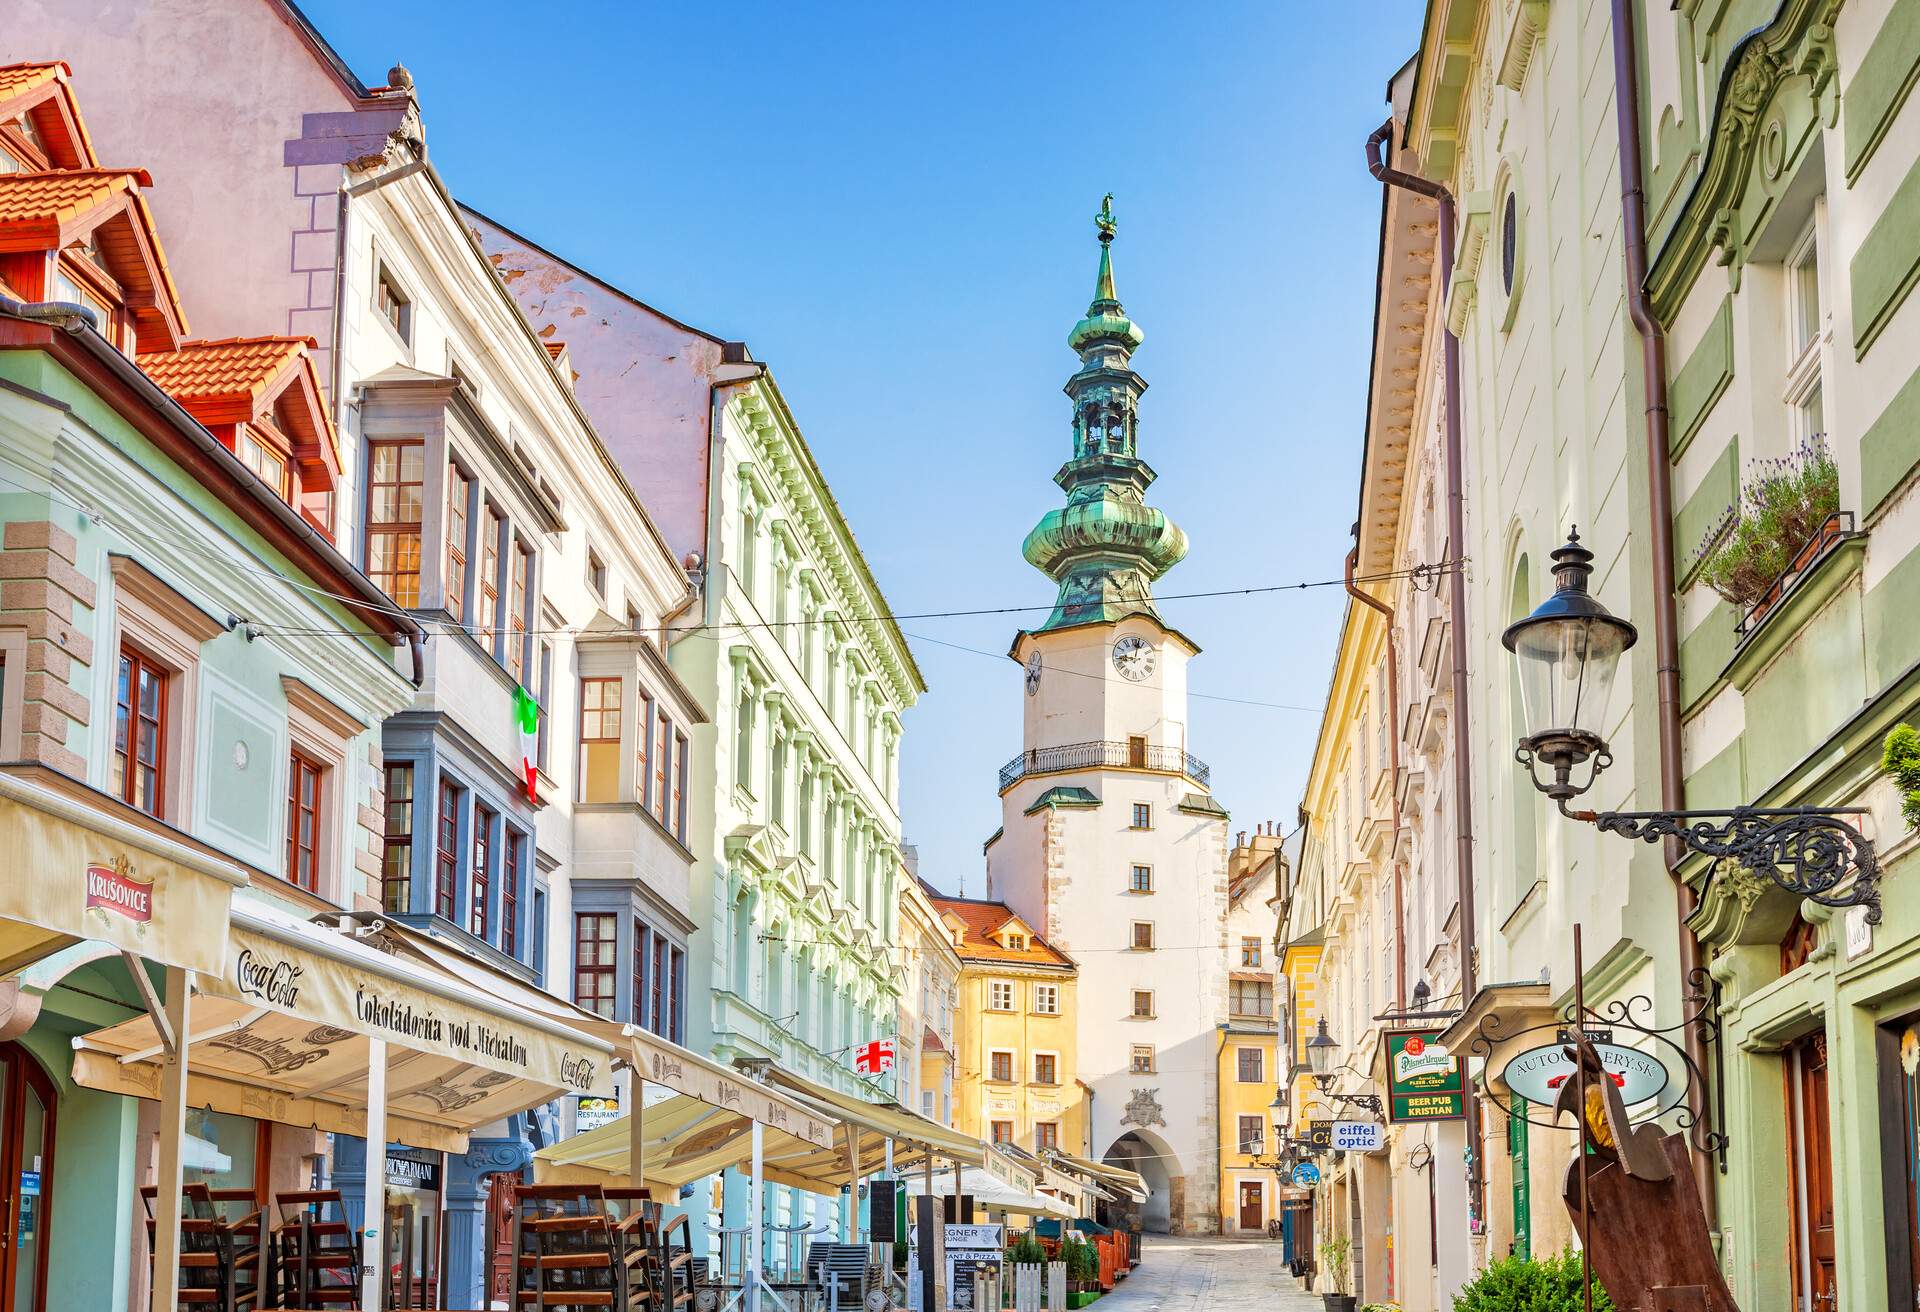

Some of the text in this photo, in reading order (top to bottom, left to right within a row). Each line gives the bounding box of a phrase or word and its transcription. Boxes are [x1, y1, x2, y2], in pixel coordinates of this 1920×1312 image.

[90, 872, 147, 912] KRUŠOVICE
[356, 983, 442, 1041] Čokoládovňa
[449, 1022, 470, 1048] pod
[1401, 1054, 1449, 1073] Pilsner Urquell
[1516, 1051, 1656, 1077] AUTOERY.SK
[1408, 1096, 1451, 1106] BEER PUB
[1408, 1106, 1452, 1116] KRISTIAN
[1339, 1125, 1376, 1135] eiffel
[1313, 1131, 1332, 1146] Ci
[1338, 1136, 1375, 1148] optic
[404, 1161, 432, 1180] ARMANI
[944, 1229, 978, 1237] EGNER
[973, 1252, 996, 1260] PIZZA
